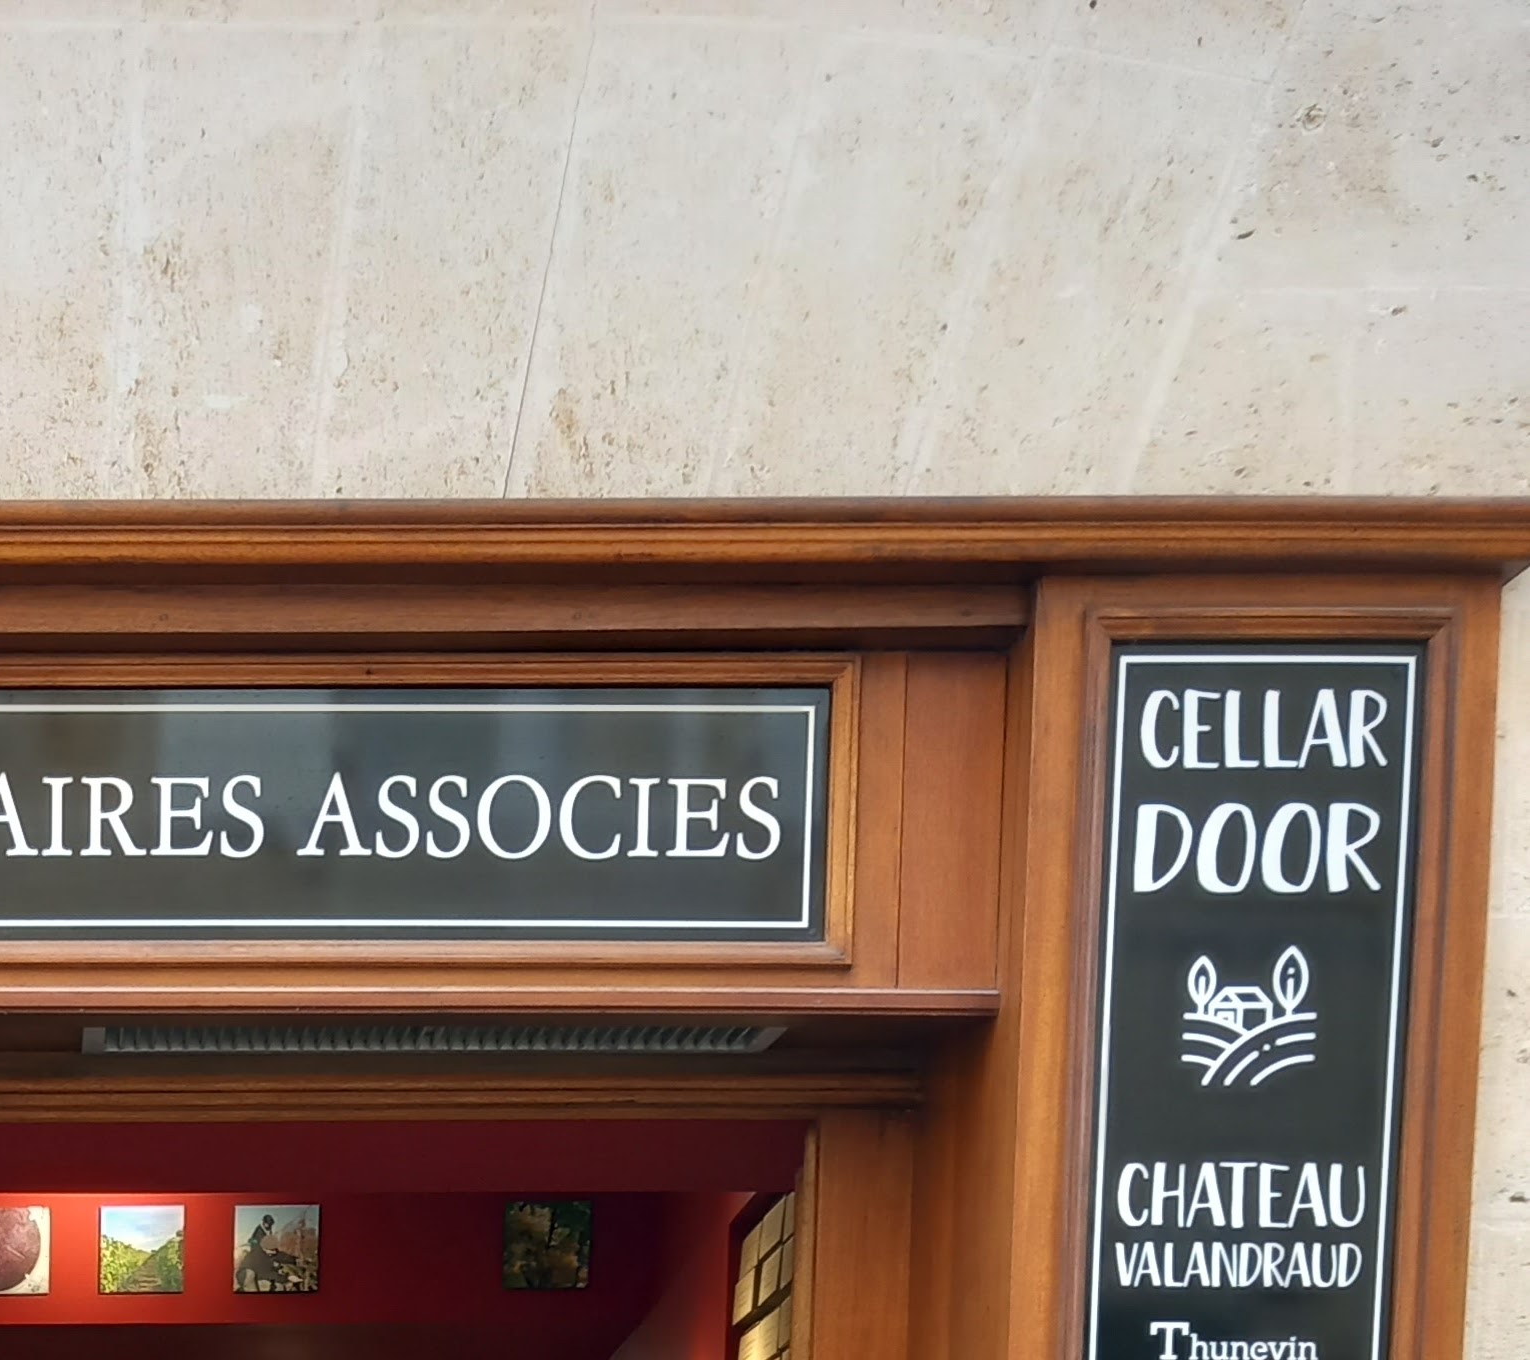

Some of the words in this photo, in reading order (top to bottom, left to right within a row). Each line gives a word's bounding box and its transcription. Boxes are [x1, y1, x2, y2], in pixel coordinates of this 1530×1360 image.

[1141, 689, 1387, 768] CELLAR
[297, 772, 780, 859] ASSOCIES
[1134, 803, 1380, 893] DOOR
[1118, 1162, 1365, 1228] CHATEAU
[1115, 1242, 1362, 1287] VALANDRAUD
[1150, 1322, 1318, 1360] Thunevin
